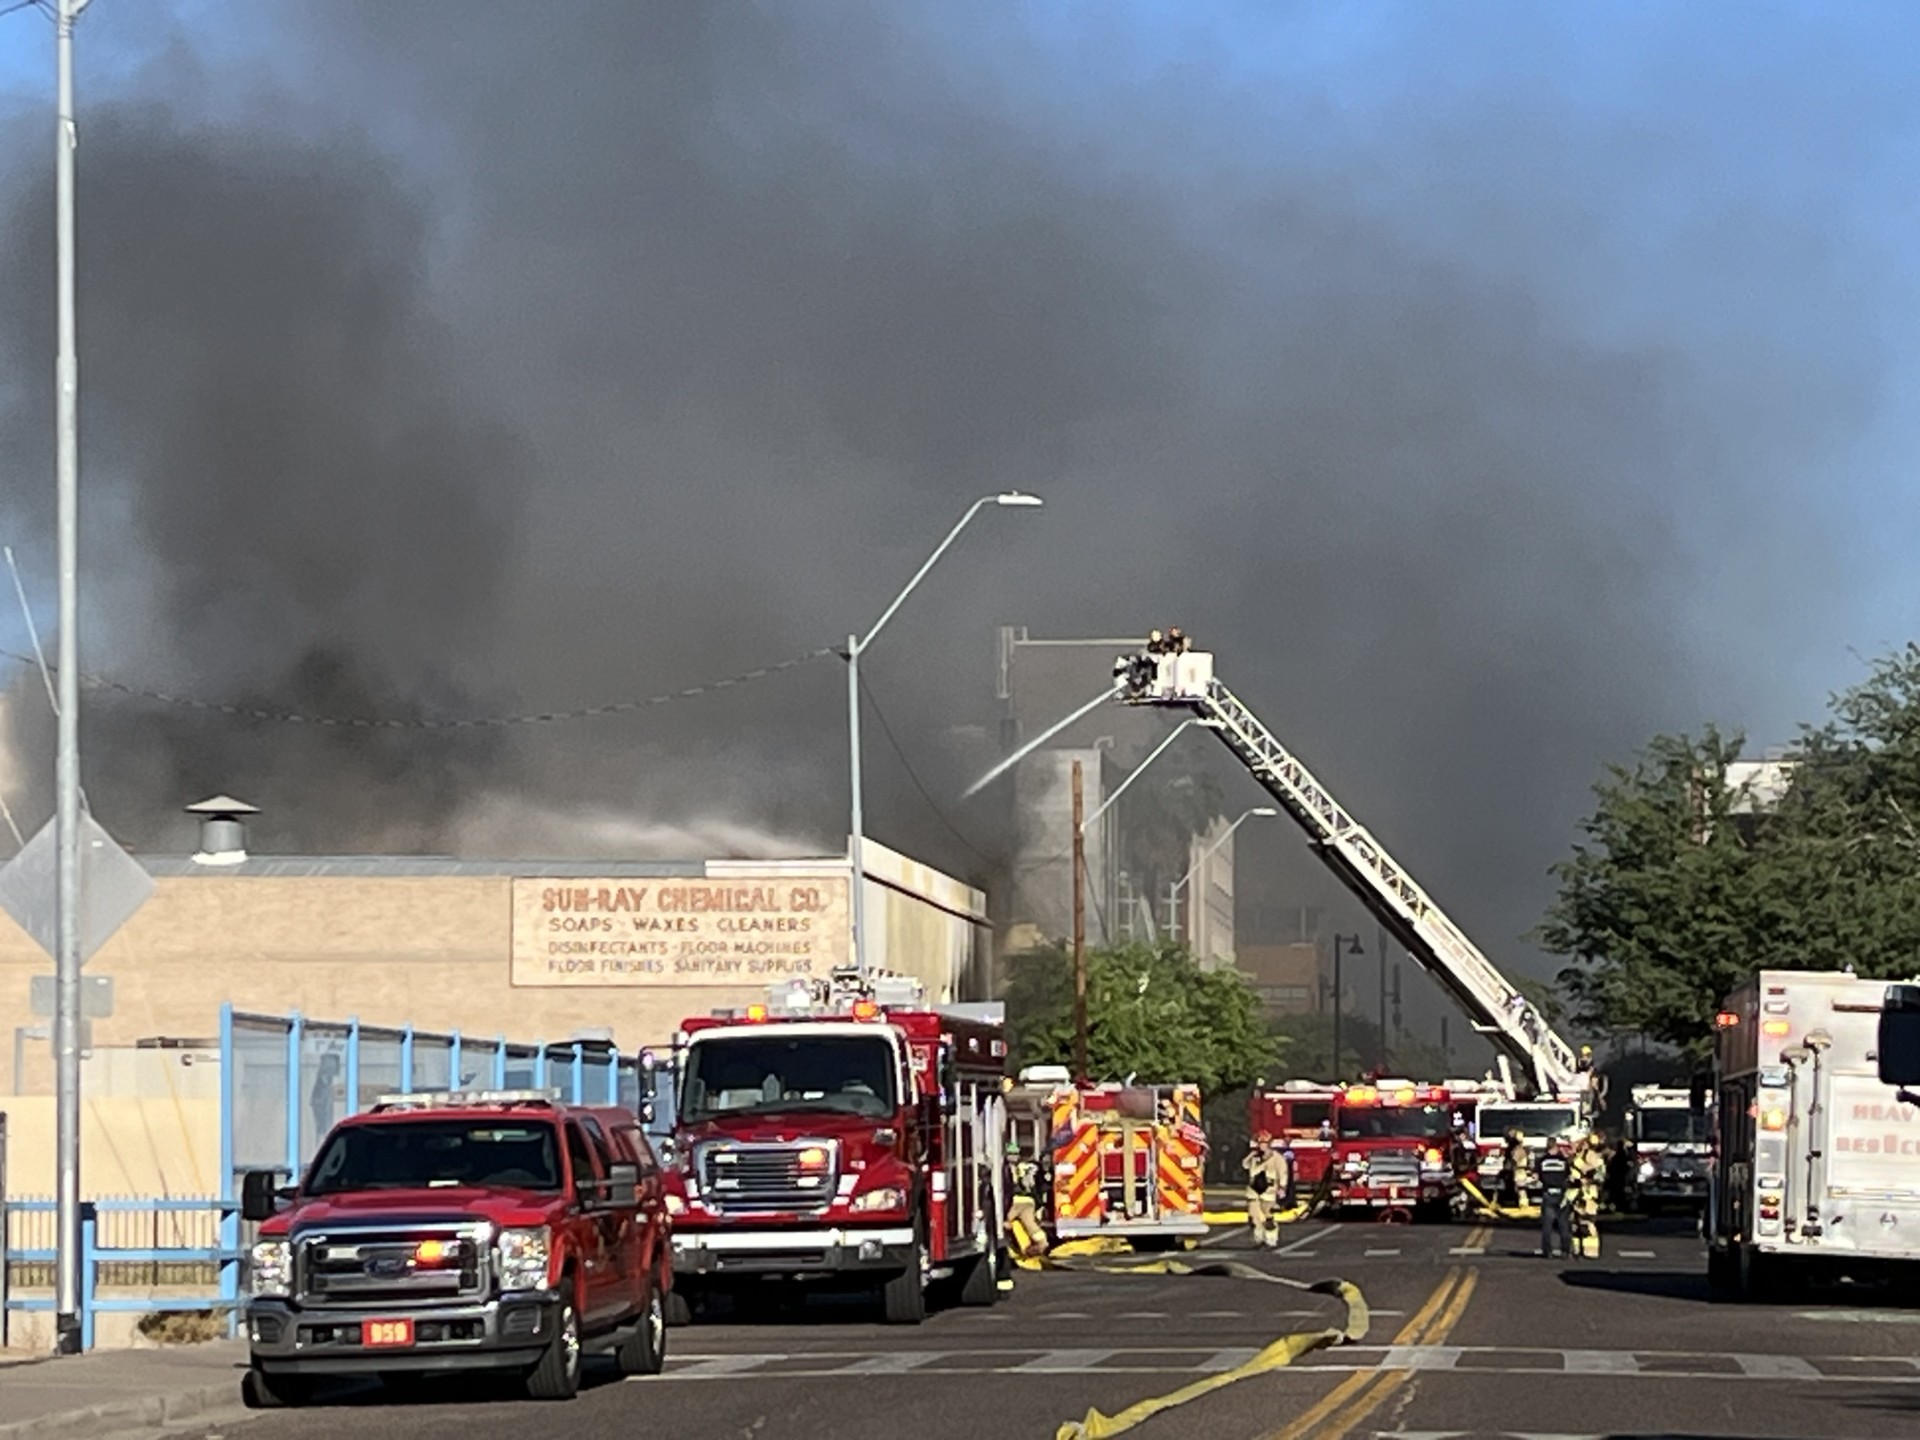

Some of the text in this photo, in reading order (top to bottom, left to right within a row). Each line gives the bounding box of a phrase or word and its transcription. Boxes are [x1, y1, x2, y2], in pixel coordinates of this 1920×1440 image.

[542, 887, 648, 912] SUN-RAY
[657, 887, 781, 912] CHEMICAL
[548, 917, 811, 932] SOAPS WAXES CLEANERS
[548, 941, 811, 955] DISINFECTANTS FLOOR MACHINES
[548, 959, 595, 974] FLOOR
[674, 958, 742, 974] SANITARY
[748, 958, 812, 974] SUPPLIES
